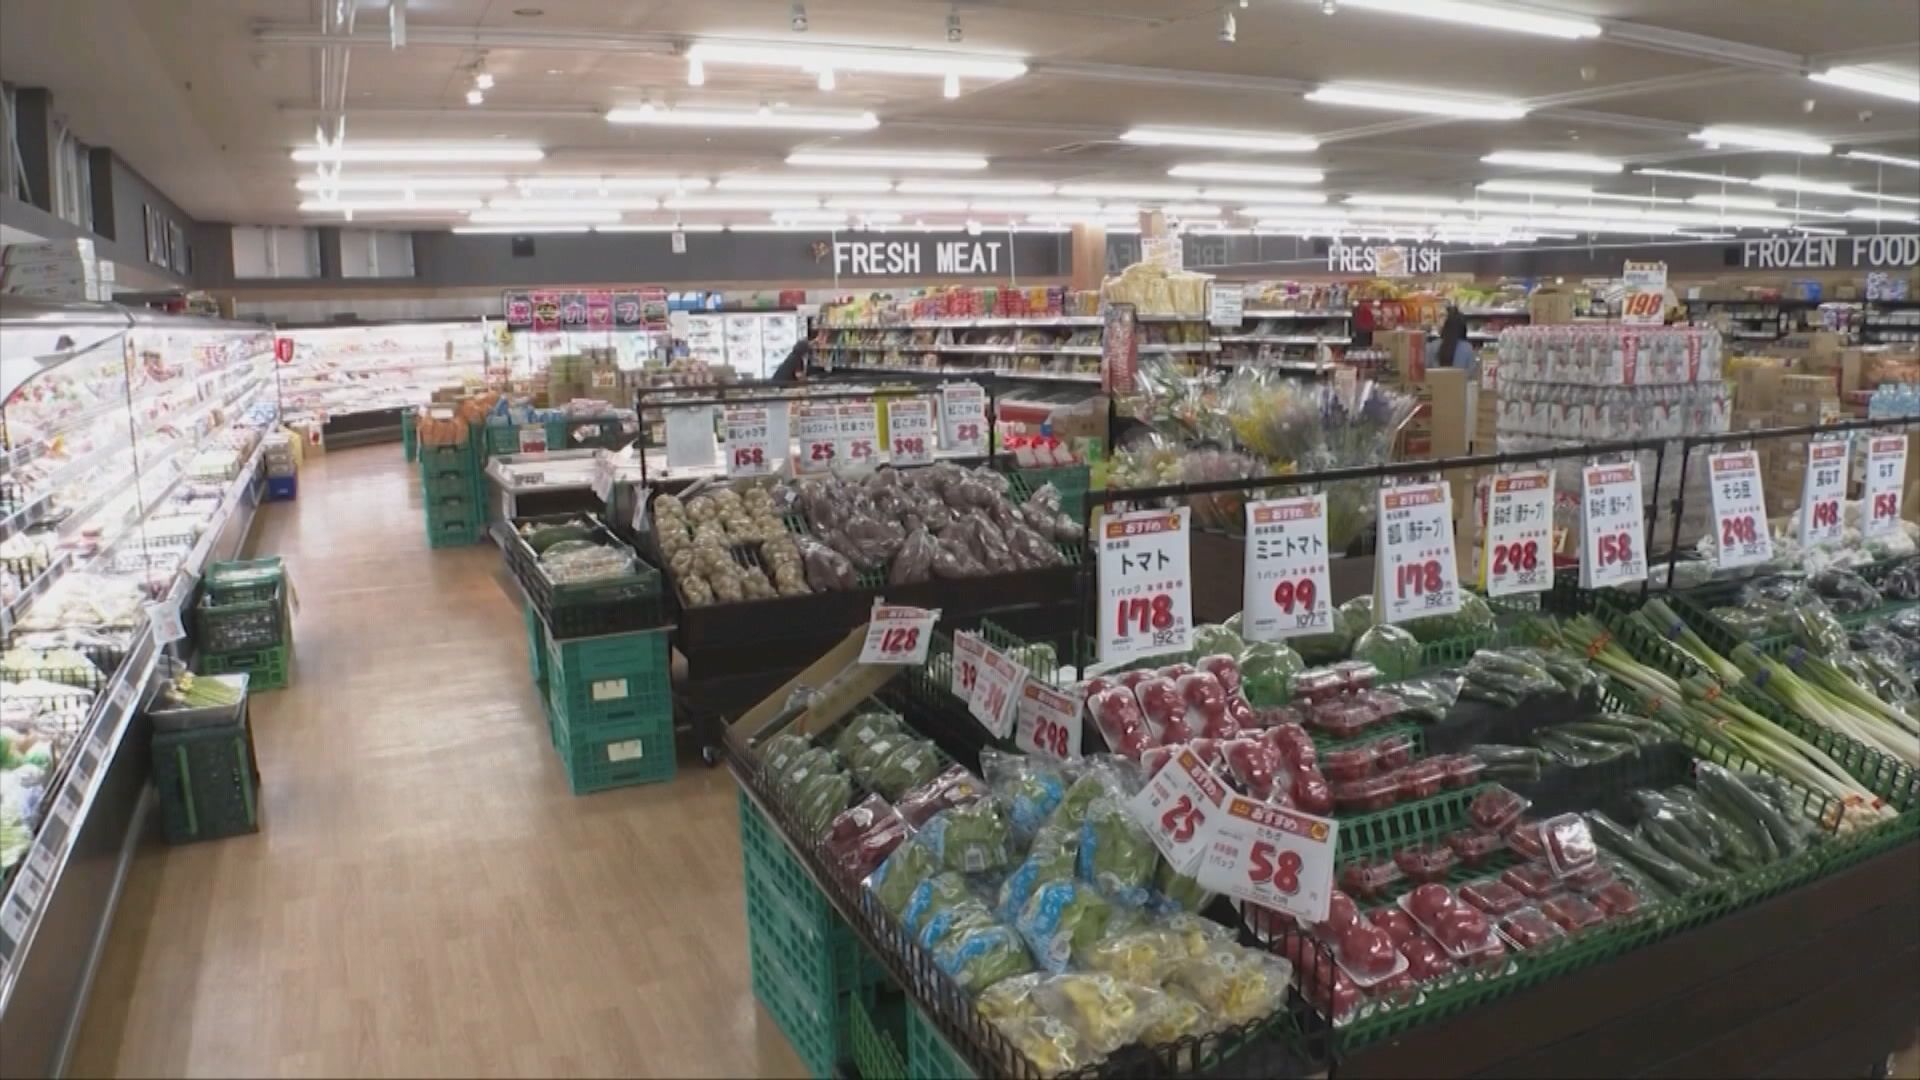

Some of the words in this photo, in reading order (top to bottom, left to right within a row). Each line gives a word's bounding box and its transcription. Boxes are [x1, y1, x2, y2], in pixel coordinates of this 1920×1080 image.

[834, 242, 921, 274] FRESH
[936, 242, 1002, 274] MEAT
[1328, 246, 1377, 272] FRES
[1404, 246, 1441, 272] ISH
[1743, 237, 1837, 267] FROZEN
[1624, 292, 1663, 316] 198
[735, 448, 764, 467] 158
[811, 443, 835, 461] 25
[851, 441, 873, 458] 25
[1723, 480, 1752, 499] そら豆
[1272, 507, 1305, 520] おすすめ
[1812, 500, 1838, 529] 198
[1873, 494, 1897, 519] 158
[1125, 521, 1162, 534] おすすめ
[1722, 516, 1757, 547] 298
[1256, 533, 1322, 559] ミニトマト
[1493, 541, 1538, 575] 298
[1598, 533, 1633, 567] 158
[1121, 549, 1170, 576] トマト
[1397, 560, 1444, 599] 178
[1274, 578, 1317, 615] 99
[1117, 594, 1175, 637] 178
[1296, 612, 1316, 628] 107
[880, 628, 919, 652] 128
[1152, 630, 1174, 647] 192
[1033, 715, 1069, 758] 298
[1190, 765, 1217, 796] おすすめ
[1162, 794, 1205, 842] 25
[1251, 806, 1298, 830] おすすめ
[1248, 840, 1303, 895] 58
